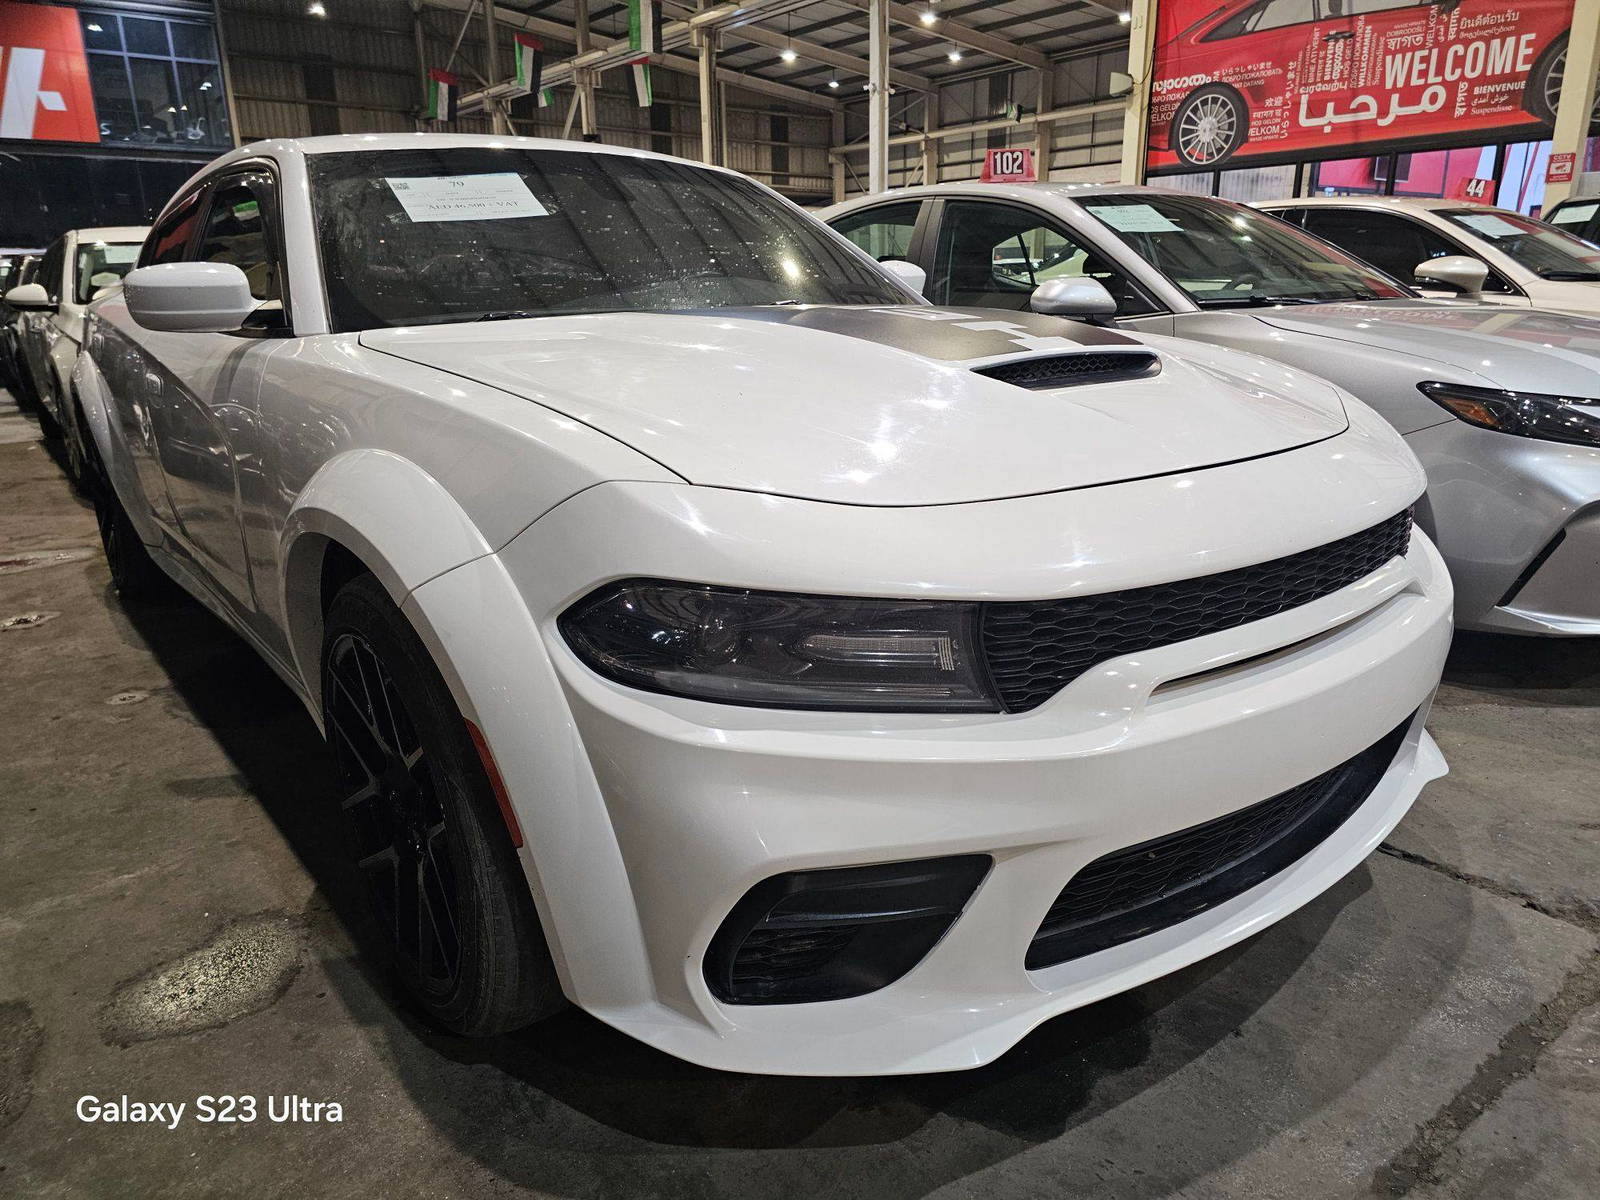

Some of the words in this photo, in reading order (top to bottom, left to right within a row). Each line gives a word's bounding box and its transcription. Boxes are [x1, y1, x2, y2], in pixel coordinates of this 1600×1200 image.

[1358, 26, 1372, 87] WILLKOMMEN
[1385, 32, 1536, 90] WELCOME
[1473, 80, 1526, 95] BIENVENUE
[1299, 86, 1446, 132] مرحبا
[994, 152, 1022, 174] 102
[1466, 180, 1486, 198] 44
